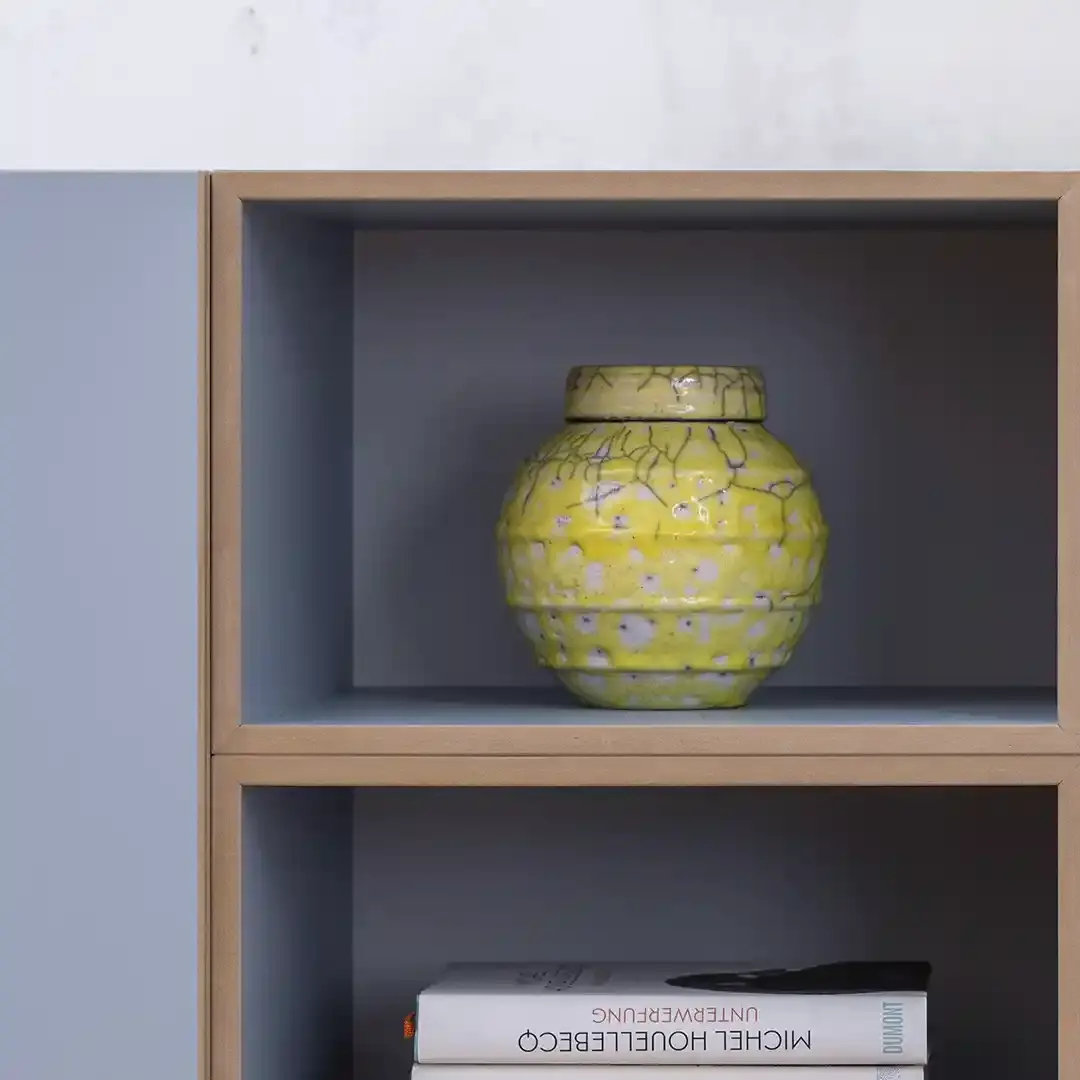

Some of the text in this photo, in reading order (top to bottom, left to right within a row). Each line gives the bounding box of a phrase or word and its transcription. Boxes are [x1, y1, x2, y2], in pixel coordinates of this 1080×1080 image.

[591, 1006, 759, 1024] UNTERWERFUNG
[882, 1001, 904, 1054] DUMONT
[518, 1029, 811, 1053] MICHEL HOUELLEBECQ
